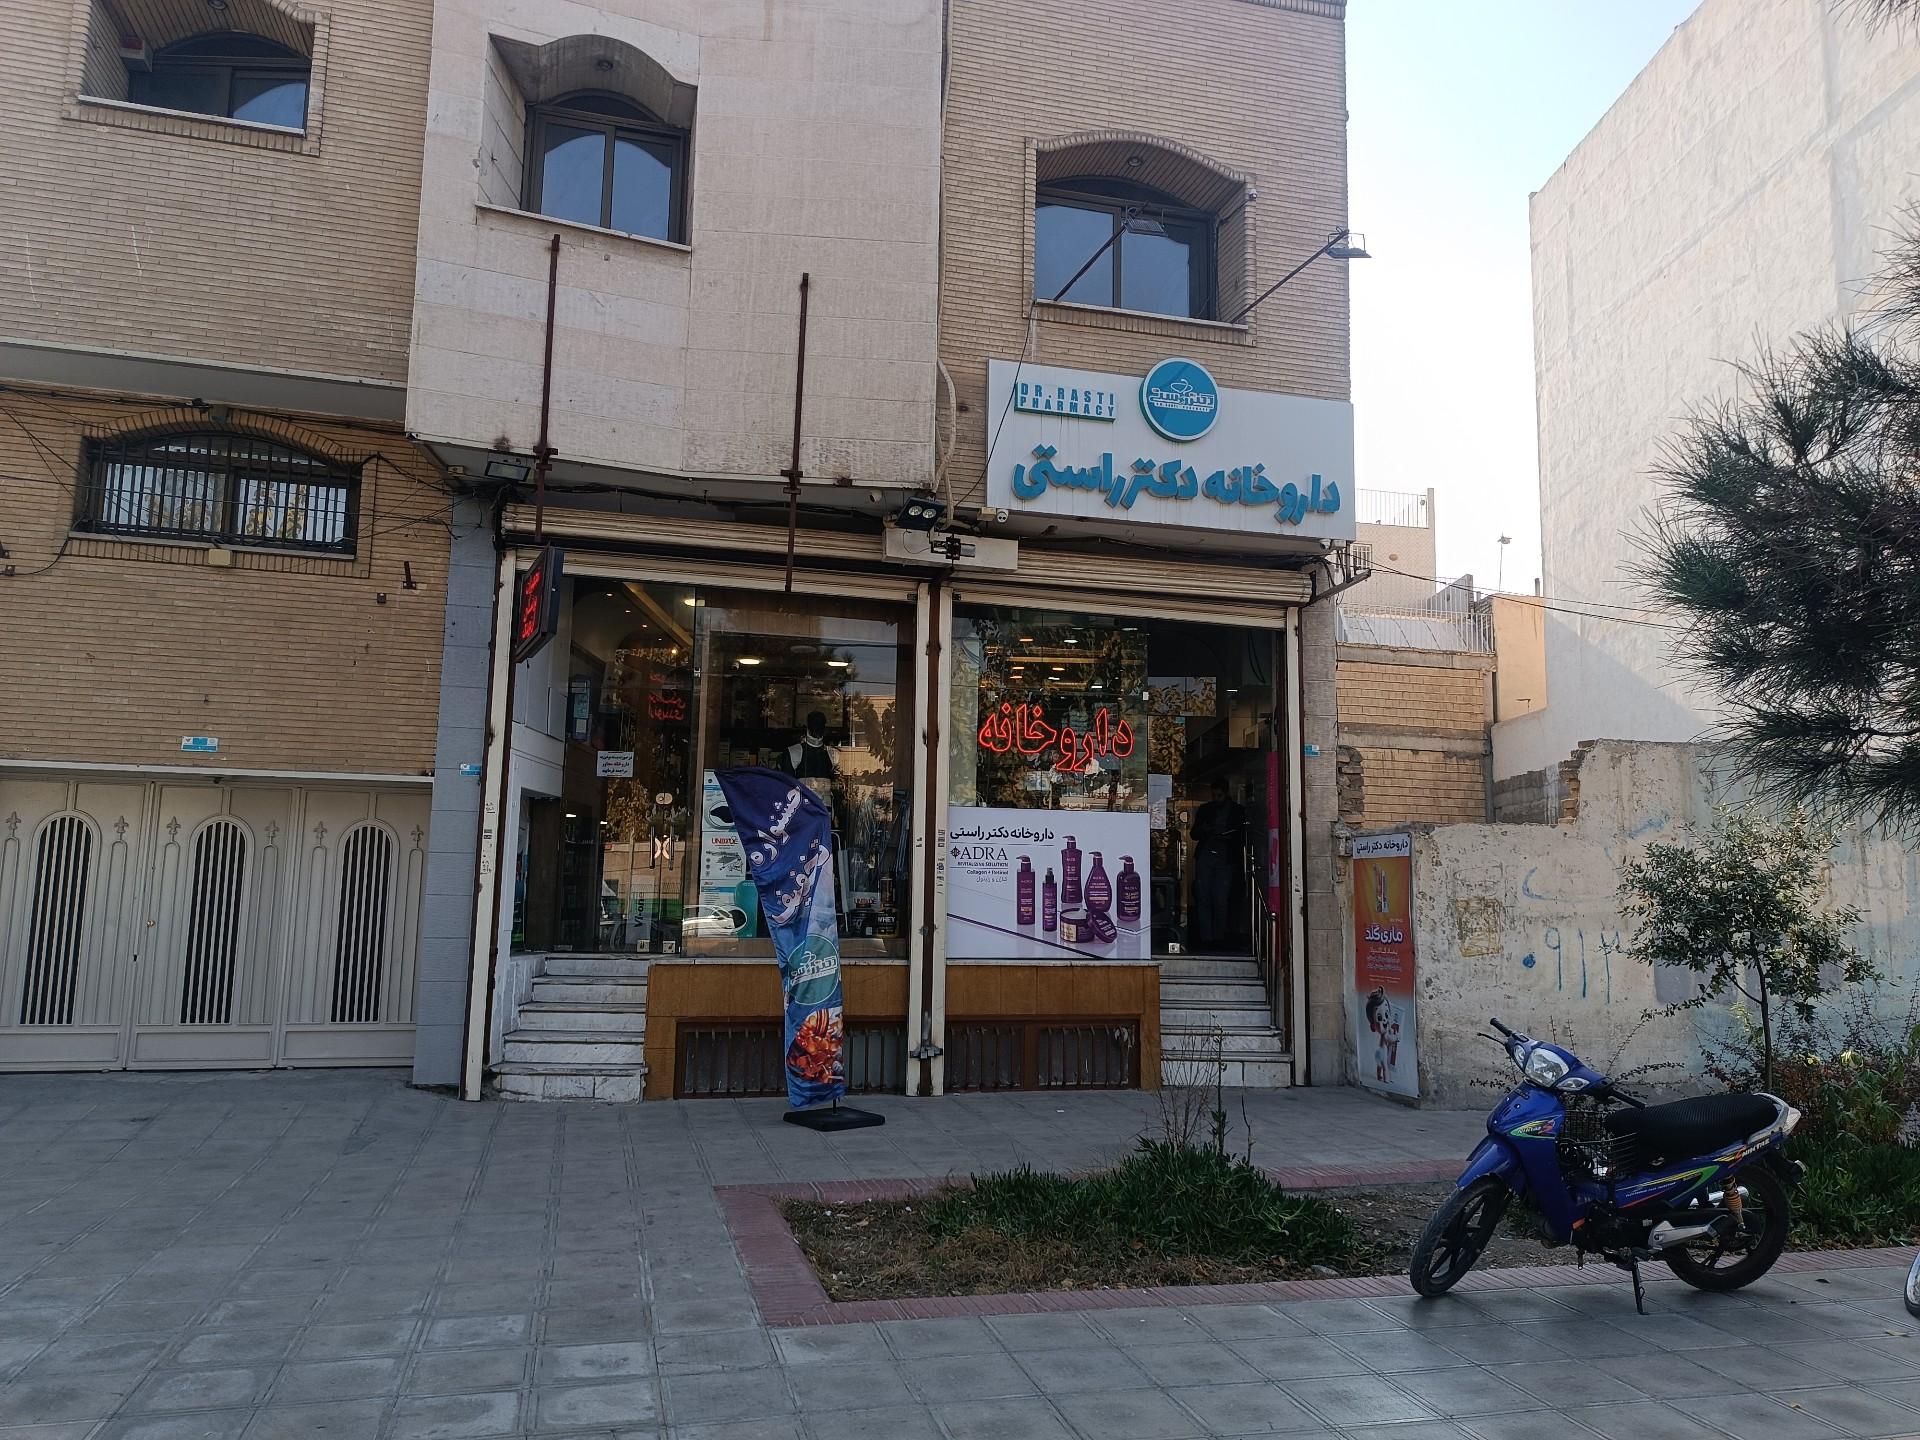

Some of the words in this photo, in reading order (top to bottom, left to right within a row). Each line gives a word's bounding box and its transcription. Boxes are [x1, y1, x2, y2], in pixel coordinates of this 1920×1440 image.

[1019, 396, 1115, 418] PHARMACY
[1012, 443, 1126, 508] راستی
[1121, 458, 1199, 510] دکتر
[1203, 463, 1341, 526] داروخانه
[978, 703, 1135, 773] داروخانه
[750, 785, 810, 866] جشنواره
[950, 825, 985, 840] راستی
[985, 826, 1009, 841] دکتر
[1010, 826, 1055, 842] داروخانه
[960, 846, 1009, 861] ADRA
[1356, 841, 1371, 854] راستی
[1371, 841, 1382, 853] دکتر
[1383, 838, 1409, 852] داروخانه
[1364, 922, 1380, 941] گلد
[1380, 925, 1404, 944] ماری
